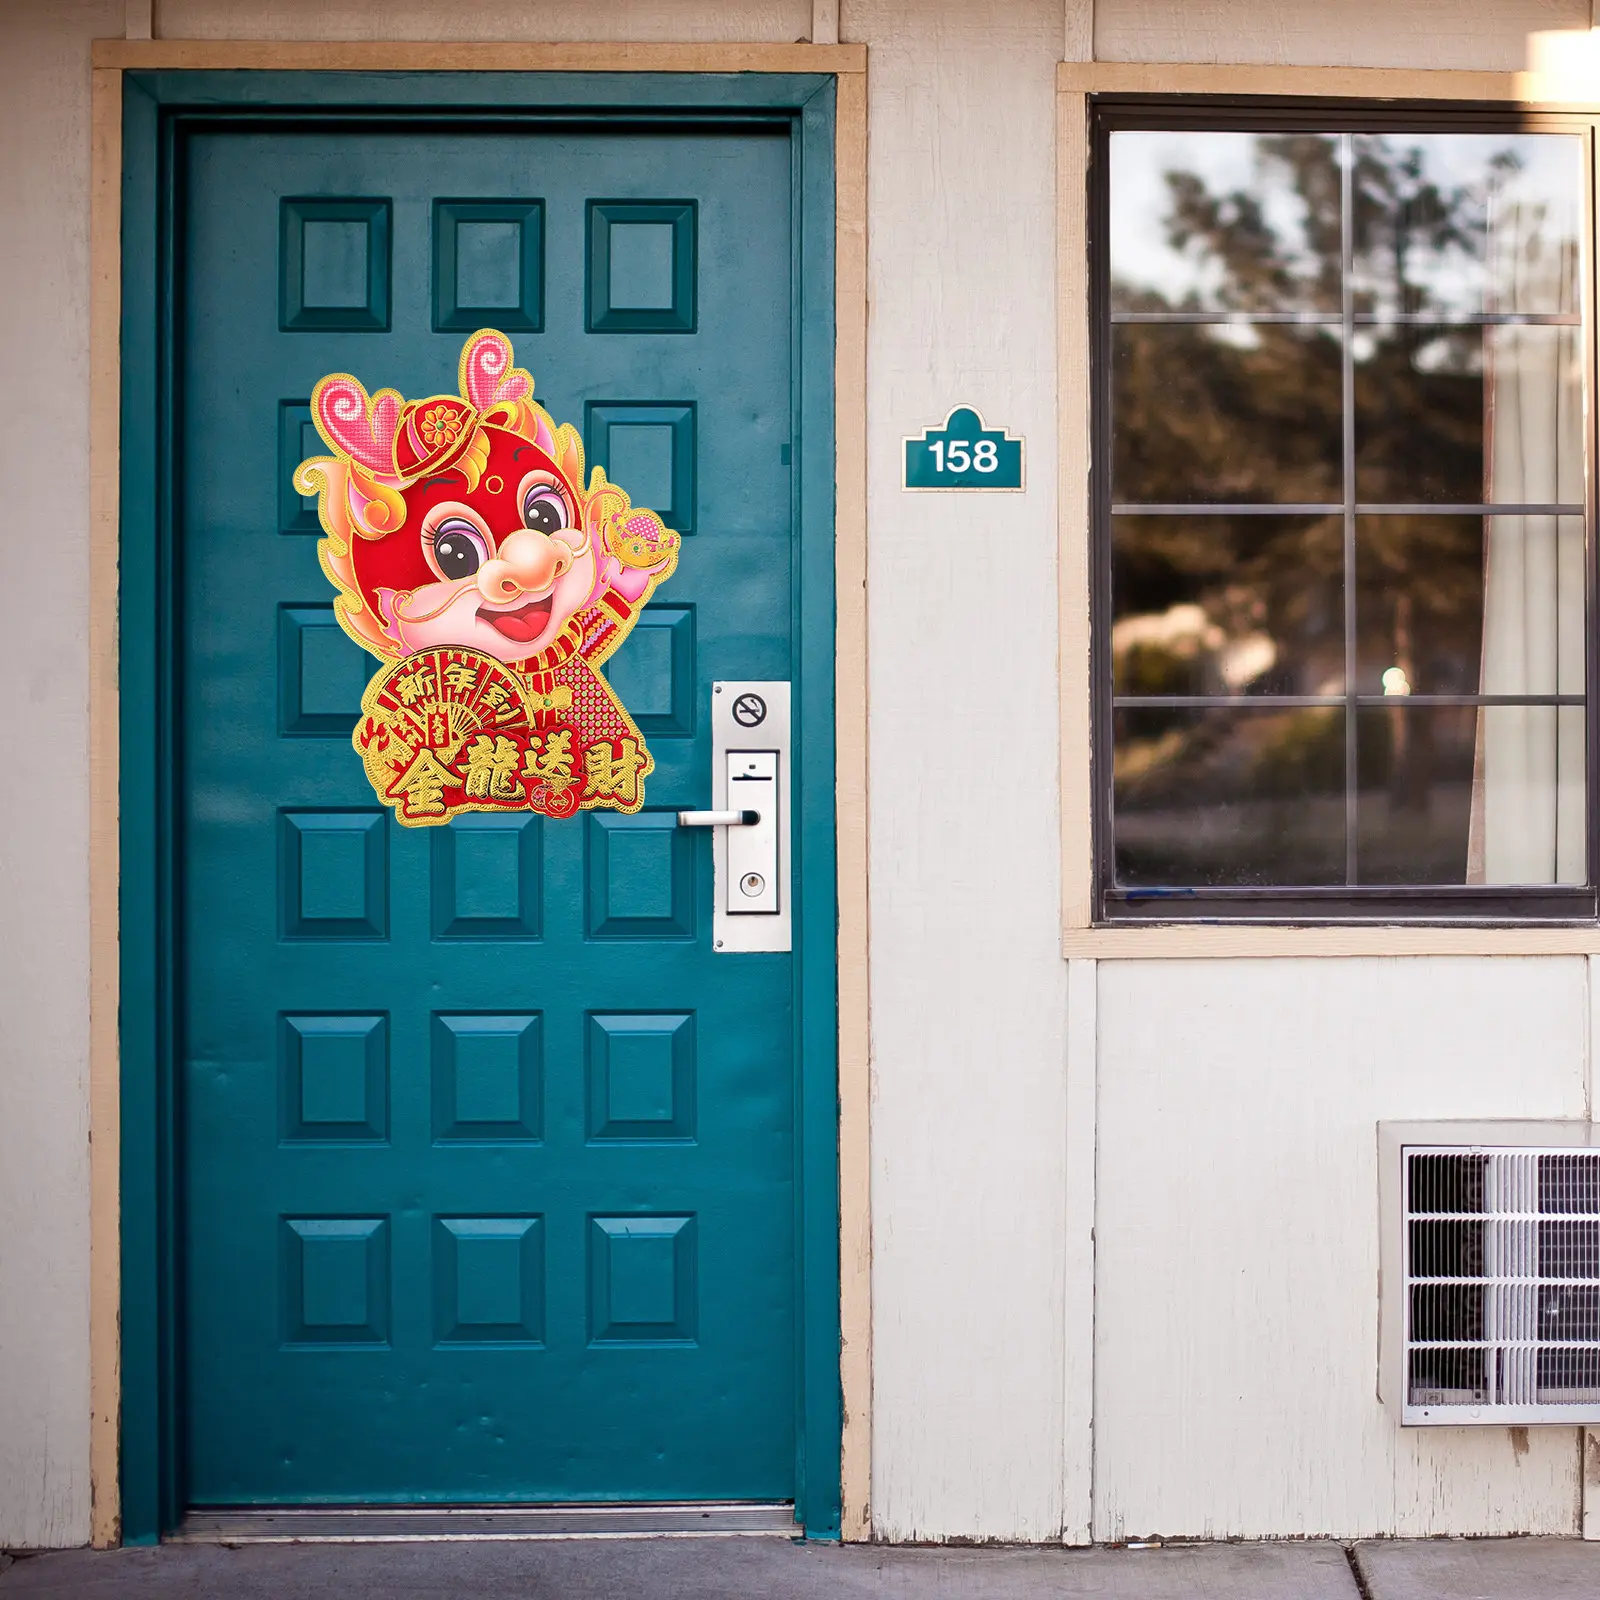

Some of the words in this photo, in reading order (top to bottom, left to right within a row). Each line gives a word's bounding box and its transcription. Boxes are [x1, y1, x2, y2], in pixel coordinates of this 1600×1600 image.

[928, 440, 999, 473] 158
[395, 662, 521, 723] 新年到
[390, 730, 646, 814] 金龍送財
